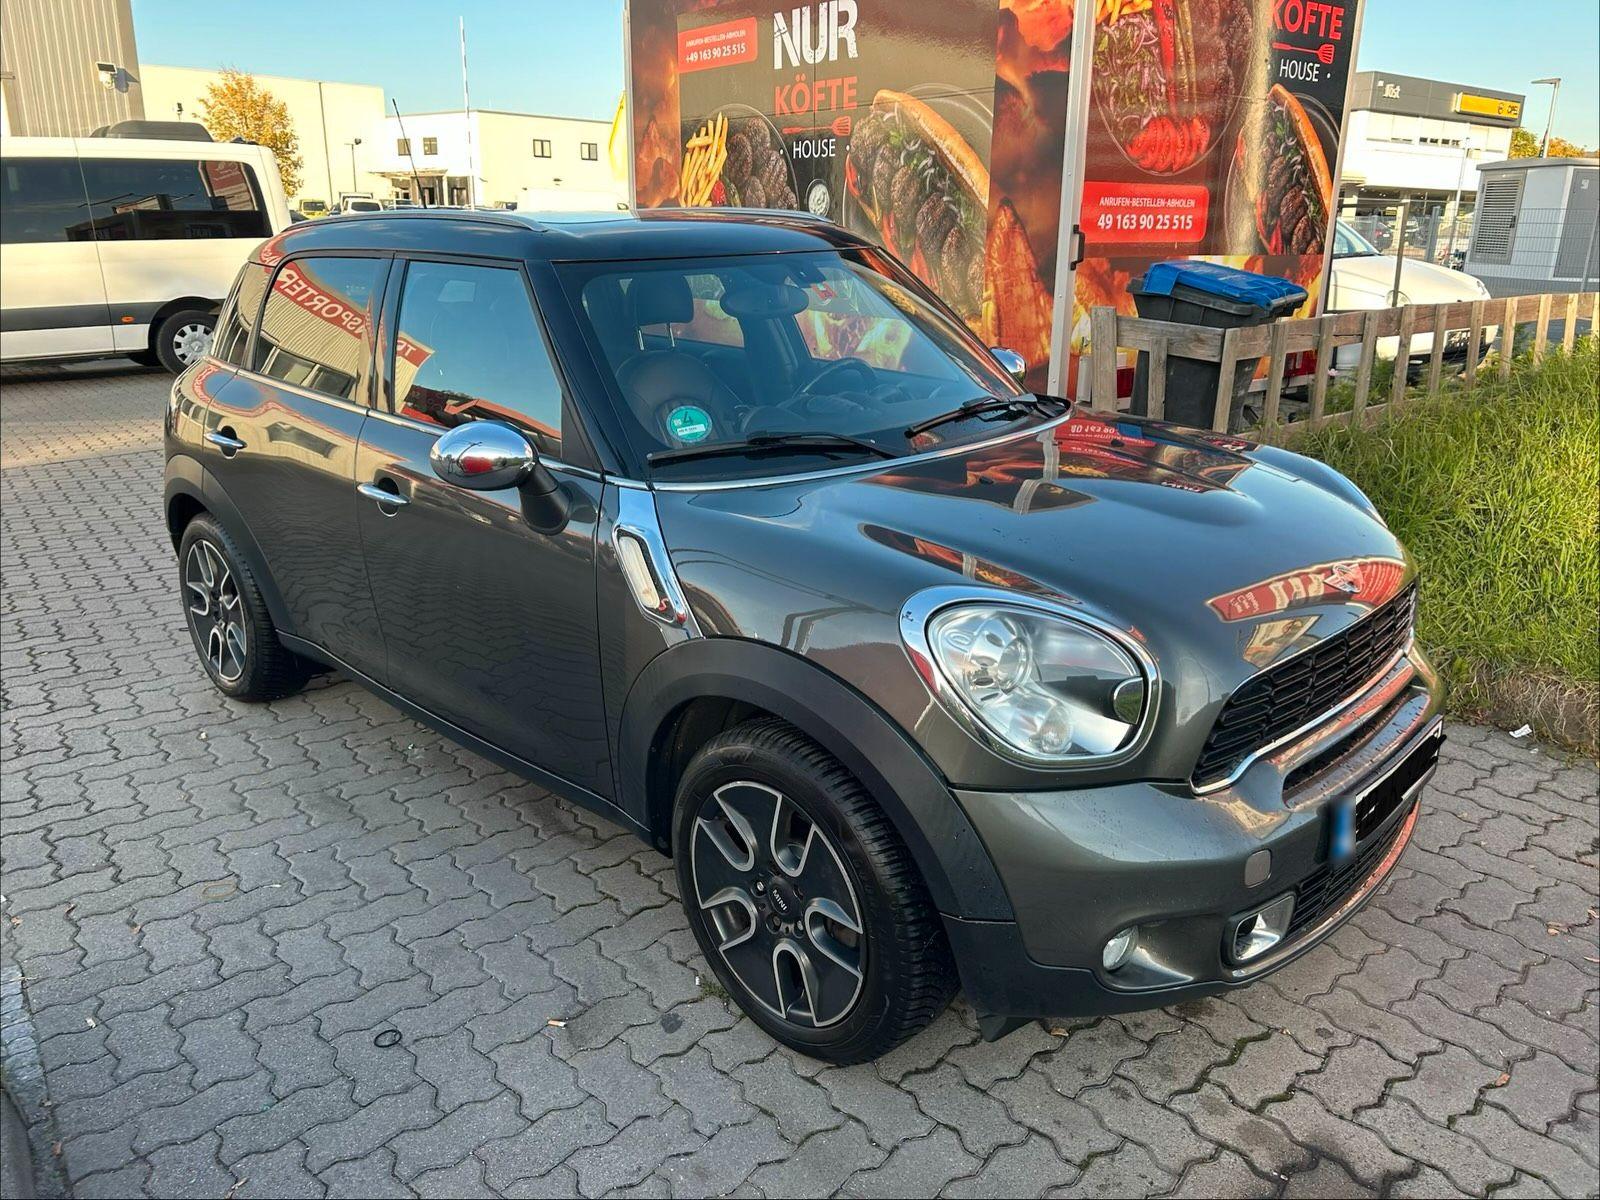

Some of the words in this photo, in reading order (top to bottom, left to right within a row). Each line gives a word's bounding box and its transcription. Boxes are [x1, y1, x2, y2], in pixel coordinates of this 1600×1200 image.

[774, 0, 858, 69] NUR
[686, 51, 698, 62] +49
[699, 49, 711, 60] 163
[712, 47, 721, 59] 90
[722, 45, 731, 57] 25
[732, 42, 746, 55] 515
[1280, 58, 1320, 82] HOUSE
[775, 73, 858, 117] KÖFTE
[793, 138, 836, 159] HOUSE
[1097, 213, 1113, 229] 49
[1116, 214, 1137, 229] 163
[1140, 214, 1154, 229] 90
[1155, 214, 1170, 230] 25
[1172, 215, 1193, 229] 515
[772, 889, 788, 911] MINI
